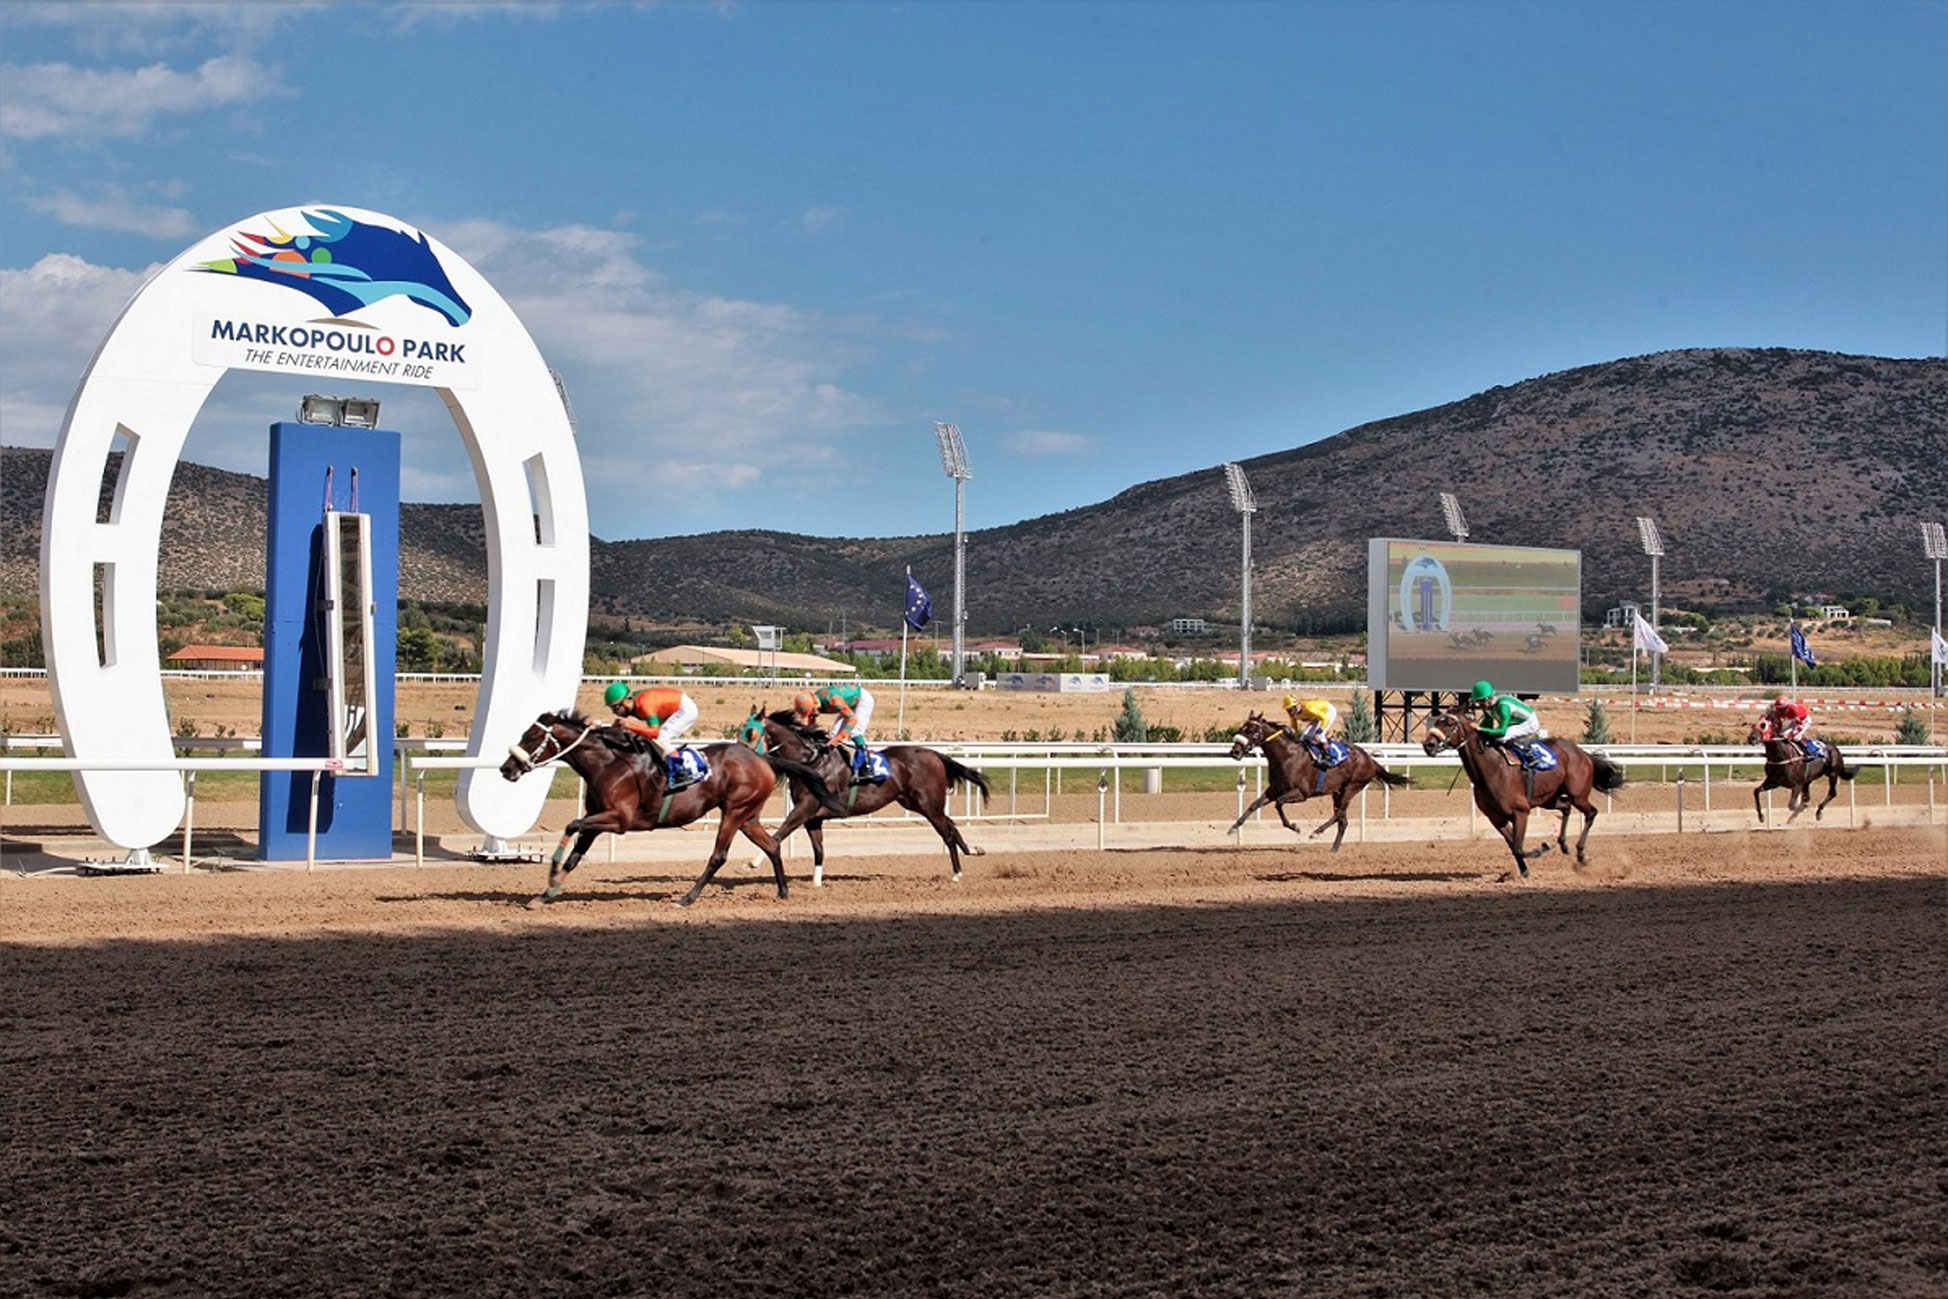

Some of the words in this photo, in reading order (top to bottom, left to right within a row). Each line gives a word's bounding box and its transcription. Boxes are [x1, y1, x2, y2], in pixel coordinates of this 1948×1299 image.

[211, 319, 395, 356] MARKOPOULO
[402, 339, 466, 363] PARK
[245, 348, 274, 365] THE
[276, 351, 400, 376] ENTERTAINMENT
[402, 363, 434, 380] RIDE
[869, 752, 889, 776] 2
